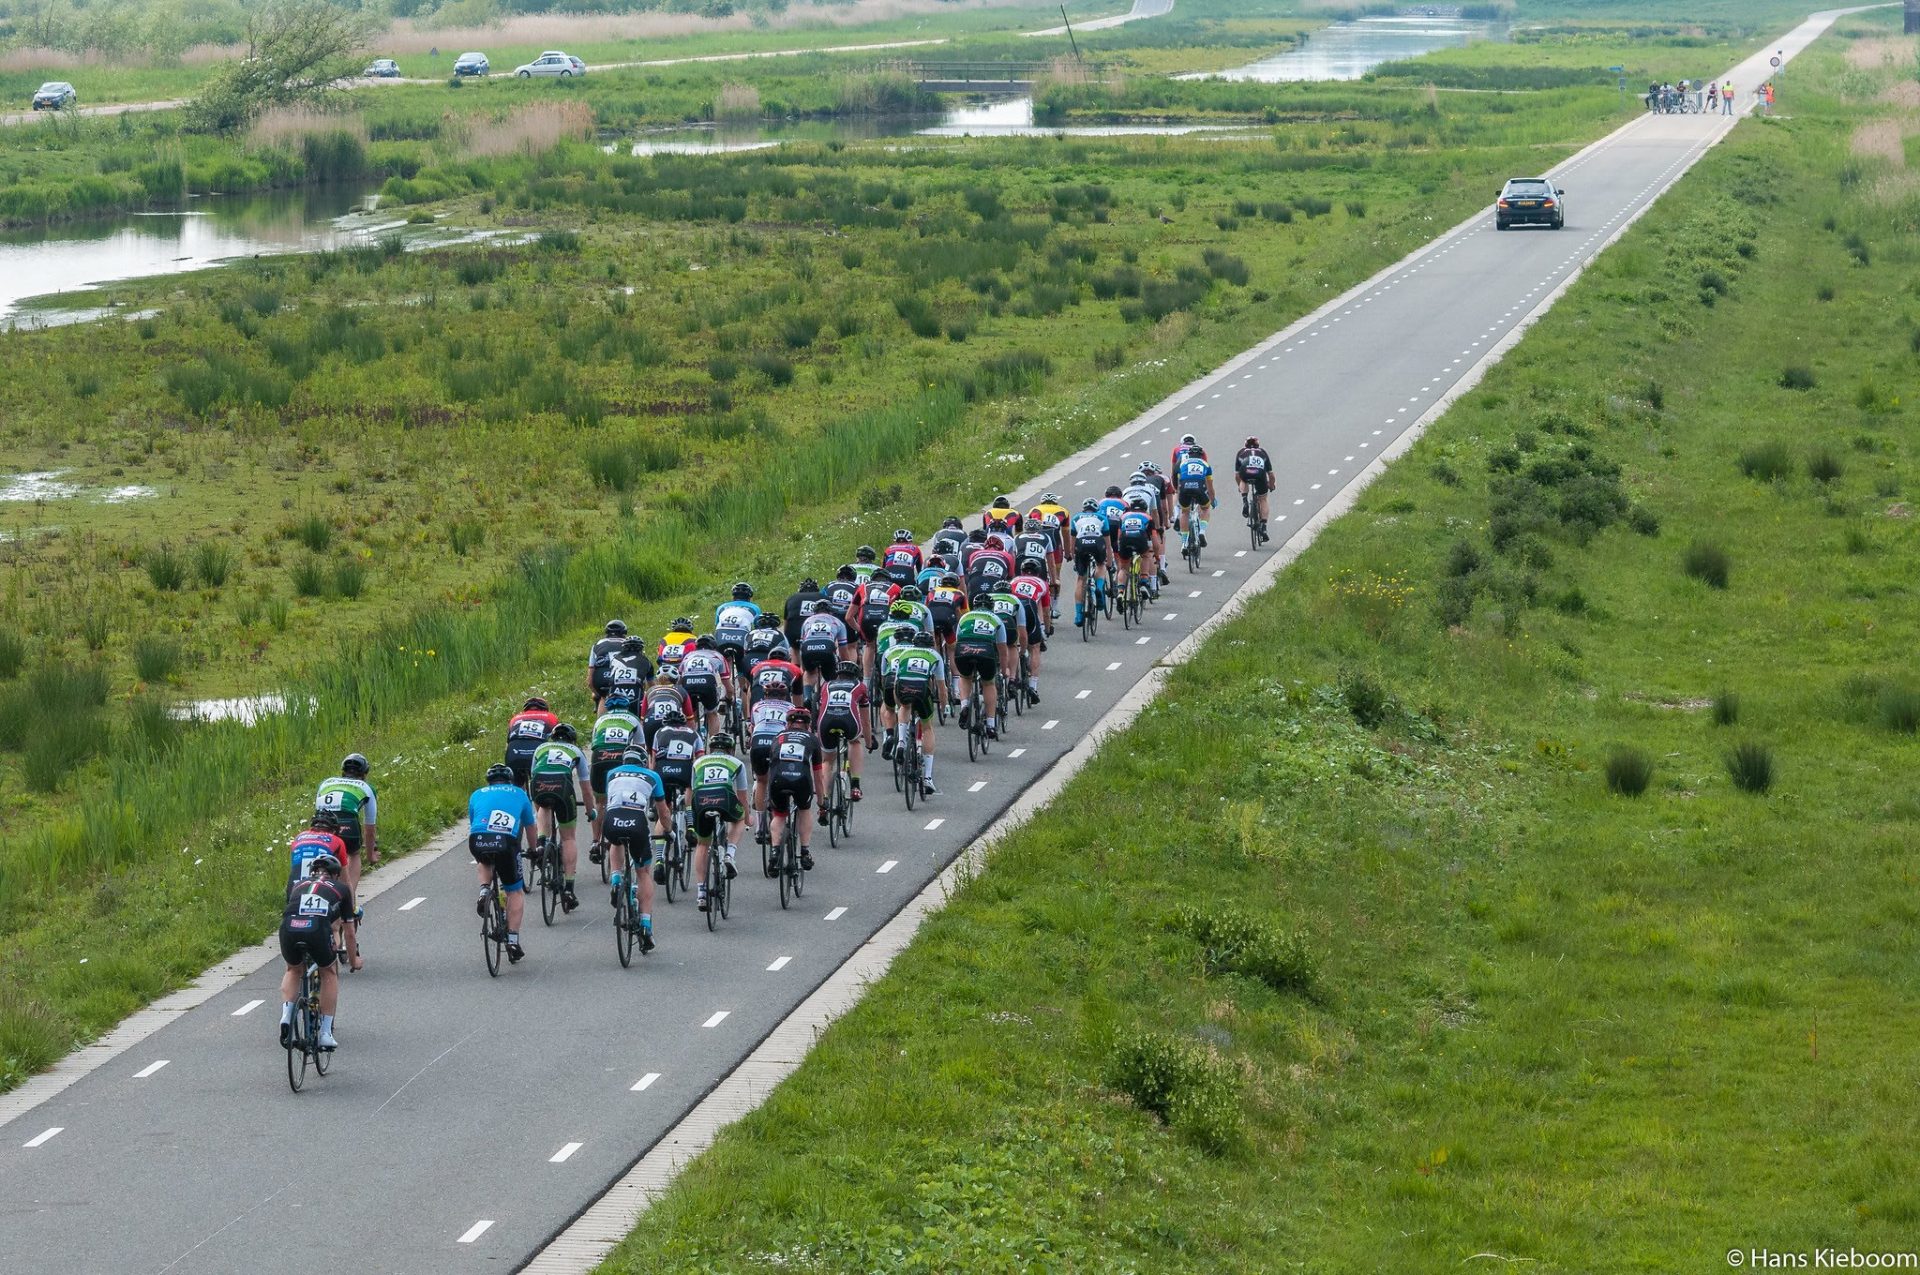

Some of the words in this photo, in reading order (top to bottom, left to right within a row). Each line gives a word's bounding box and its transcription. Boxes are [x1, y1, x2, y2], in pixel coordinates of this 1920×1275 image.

[1085, 524, 1096, 532] 43
[1029, 542, 1043, 553] 50
[896, 553, 909, 561] 40
[987, 562, 1000, 574] 28
[1019, 583, 1032, 593] 33
[836, 591, 849, 600] 48
[940, 591, 947, 599] 8
[997, 602, 1009, 610] 31
[814, 623, 827, 632] 32
[977, 621, 990, 630] 24
[721, 632, 743, 641] Tacx
[666, 646, 680, 655] 35
[691, 658, 704, 668] 54
[912, 660, 924, 668] 21
[618, 669, 631, 679] 25
[763, 672, 777, 682] 27
[613, 687, 636, 697] AXA
[832, 692, 847, 701] 44
[658, 704, 672, 714] 39
[769, 710, 783, 720] 17
[523, 722, 539, 731] 45
[609, 728, 624, 738] 58
[675, 742, 684, 754] 9
[787, 744, 795, 755] 3
[555, 750, 563, 760] 2
[708, 768, 723, 779] 37
[325, 793, 333, 805] 6
[629, 791, 638, 803] 4
[493, 812, 510, 826] 23
[613, 817, 636, 827] Tacx
[304, 896, 321, 908] 41
